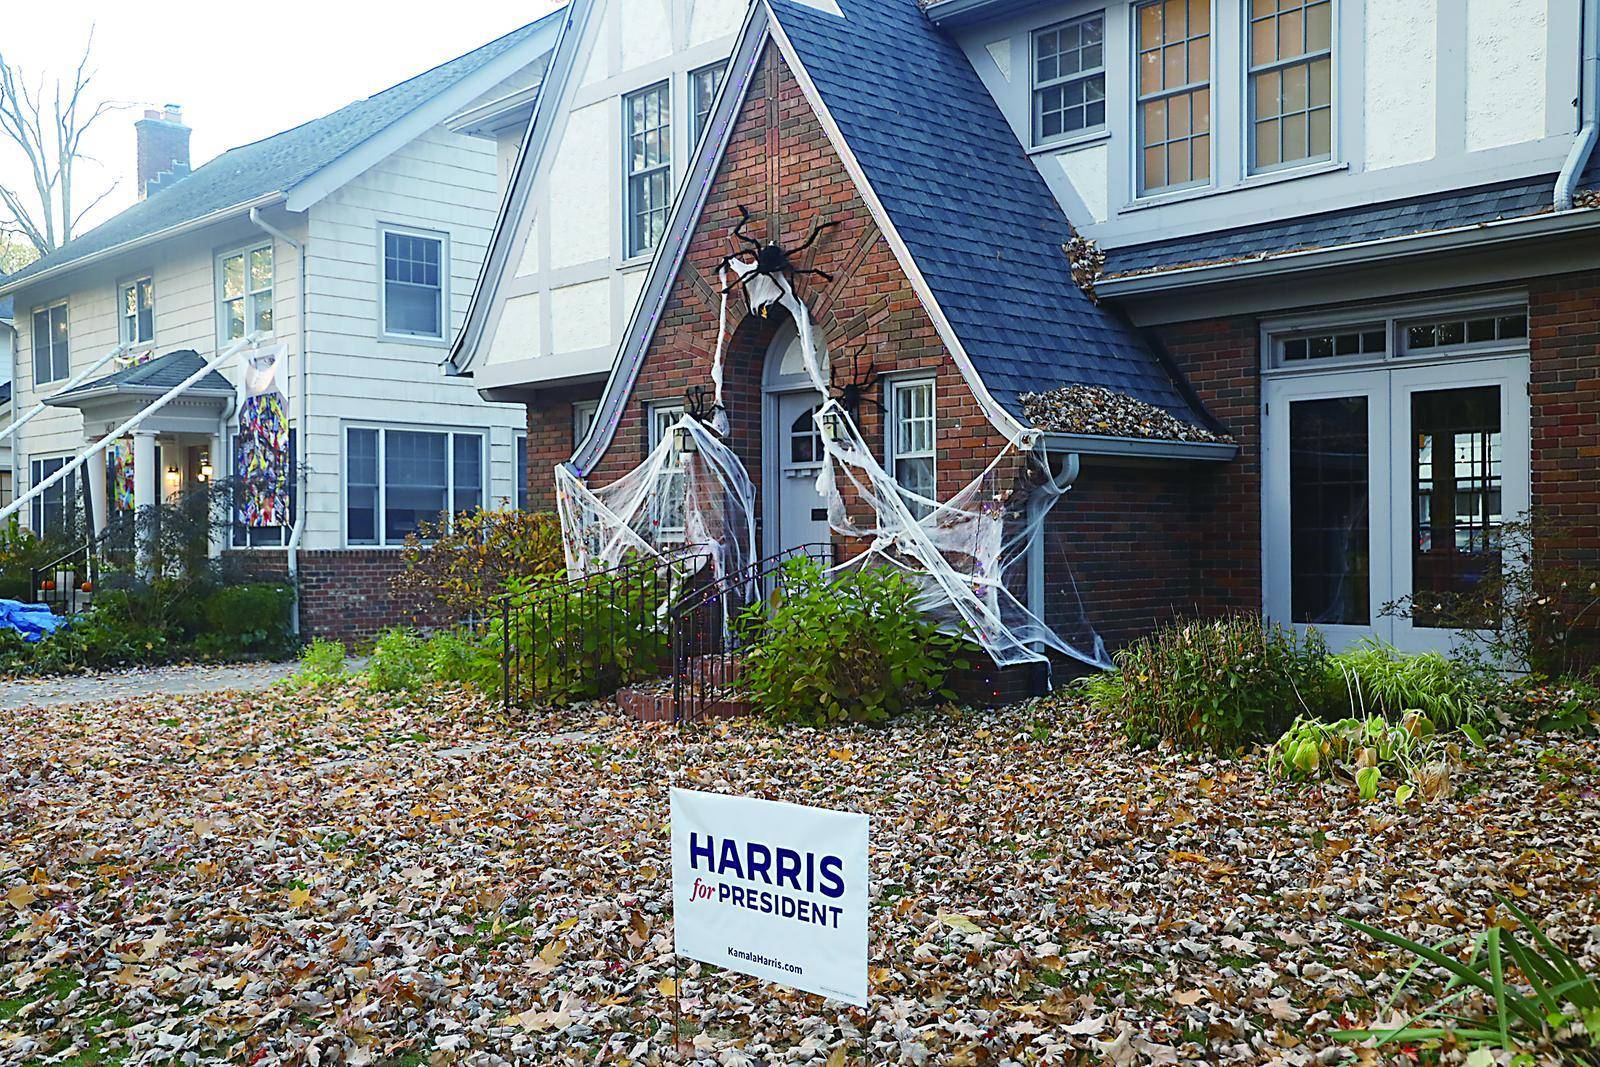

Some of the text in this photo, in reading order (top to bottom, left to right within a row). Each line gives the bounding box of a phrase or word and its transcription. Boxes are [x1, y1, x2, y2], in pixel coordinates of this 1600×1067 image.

[690, 832, 845, 898] HARRIS
[690, 877, 843, 929] for PRESIDENT
[727, 946, 803, 975] KamalaHarris.com
